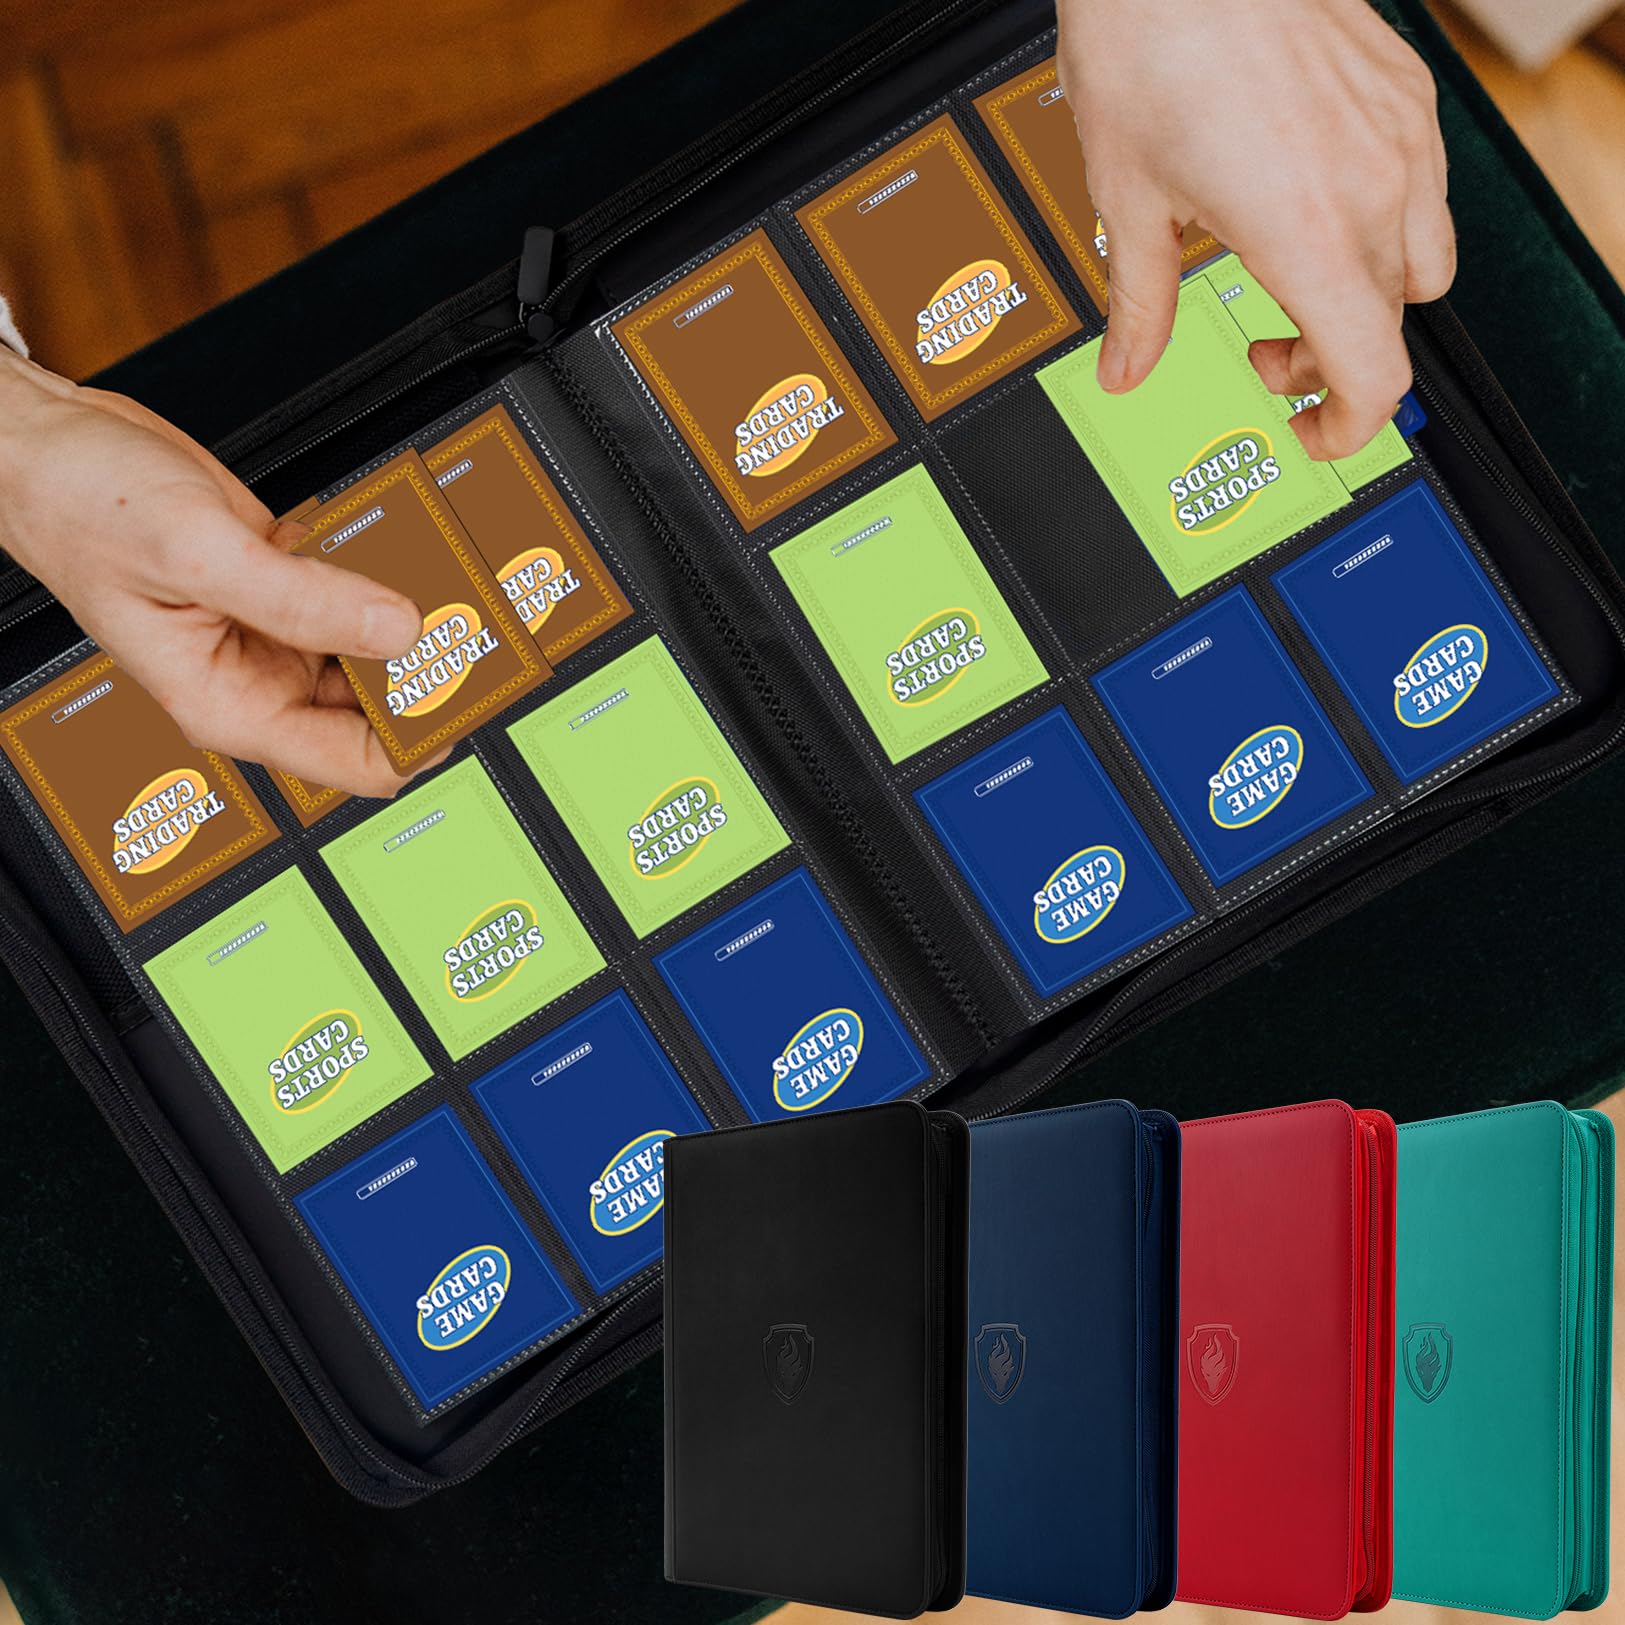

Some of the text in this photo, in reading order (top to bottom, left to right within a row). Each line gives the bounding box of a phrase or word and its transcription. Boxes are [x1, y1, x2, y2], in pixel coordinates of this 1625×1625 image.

[914, 281, 1028, 364] TRADING
[915, 270, 998, 334] CARDS
[734, 384, 815, 447] CARDS
[734, 395, 845, 476] TRADING
[1168, 438, 1259, 503] CARDS
[1177, 456, 1281, 530] SPORTS
[500, 557, 552, 601] CAR
[514, 568, 582, 624] TRAD
[385, 627, 500, 717] TRADING
[886, 617, 967, 677] CARDS
[893, 634, 986, 702] SPORTS
[1392, 634, 1475, 698] CARDS
[1411, 660, 1483, 716] GAME
[1207, 735, 1290, 798] CARDS
[1225, 760, 1298, 817] GAME
[112, 779, 195, 843] CARDS
[112, 790, 226, 874] TRADING
[627, 786, 708, 849] CARDS
[635, 803, 727, 875] SPORTS
[1032, 855, 1113, 914] CARDS
[1050, 880, 1121, 933] GAME
[443, 909, 525, 973] CARDS
[451, 925, 544, 998] SPORTS
[268, 1019, 350, 1084] CARDS
[276, 1035, 369, 1109] SPORTS
[771, 1018, 851, 1080] CARDS
[789, 1043, 859, 1099] GAME
[606, 1168, 664, 1224] AME
[415, 1255, 498, 1320] CARDS
[433, 1280, 506, 1339] GAME
